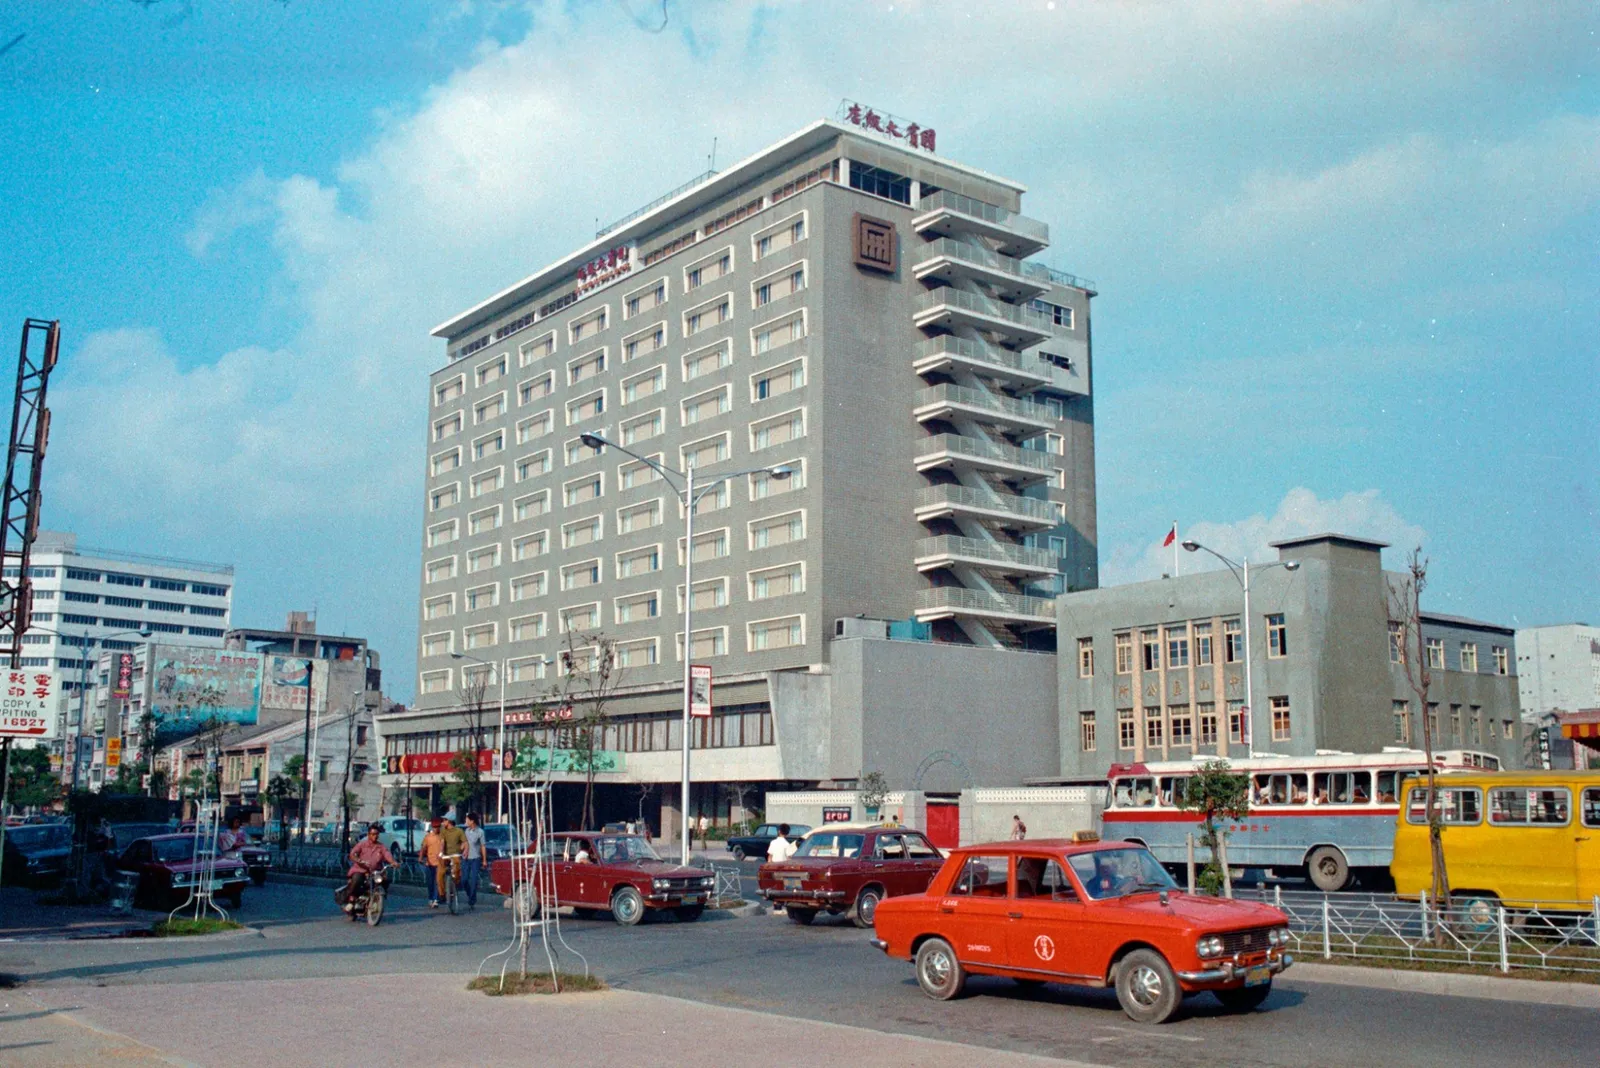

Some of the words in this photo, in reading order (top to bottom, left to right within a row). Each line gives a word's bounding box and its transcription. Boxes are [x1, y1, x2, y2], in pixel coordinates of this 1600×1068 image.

[3, 699, 31, 708] COPY
[0, 709, 38, 717] PITING
[3, 718, 46, 727] 16527
